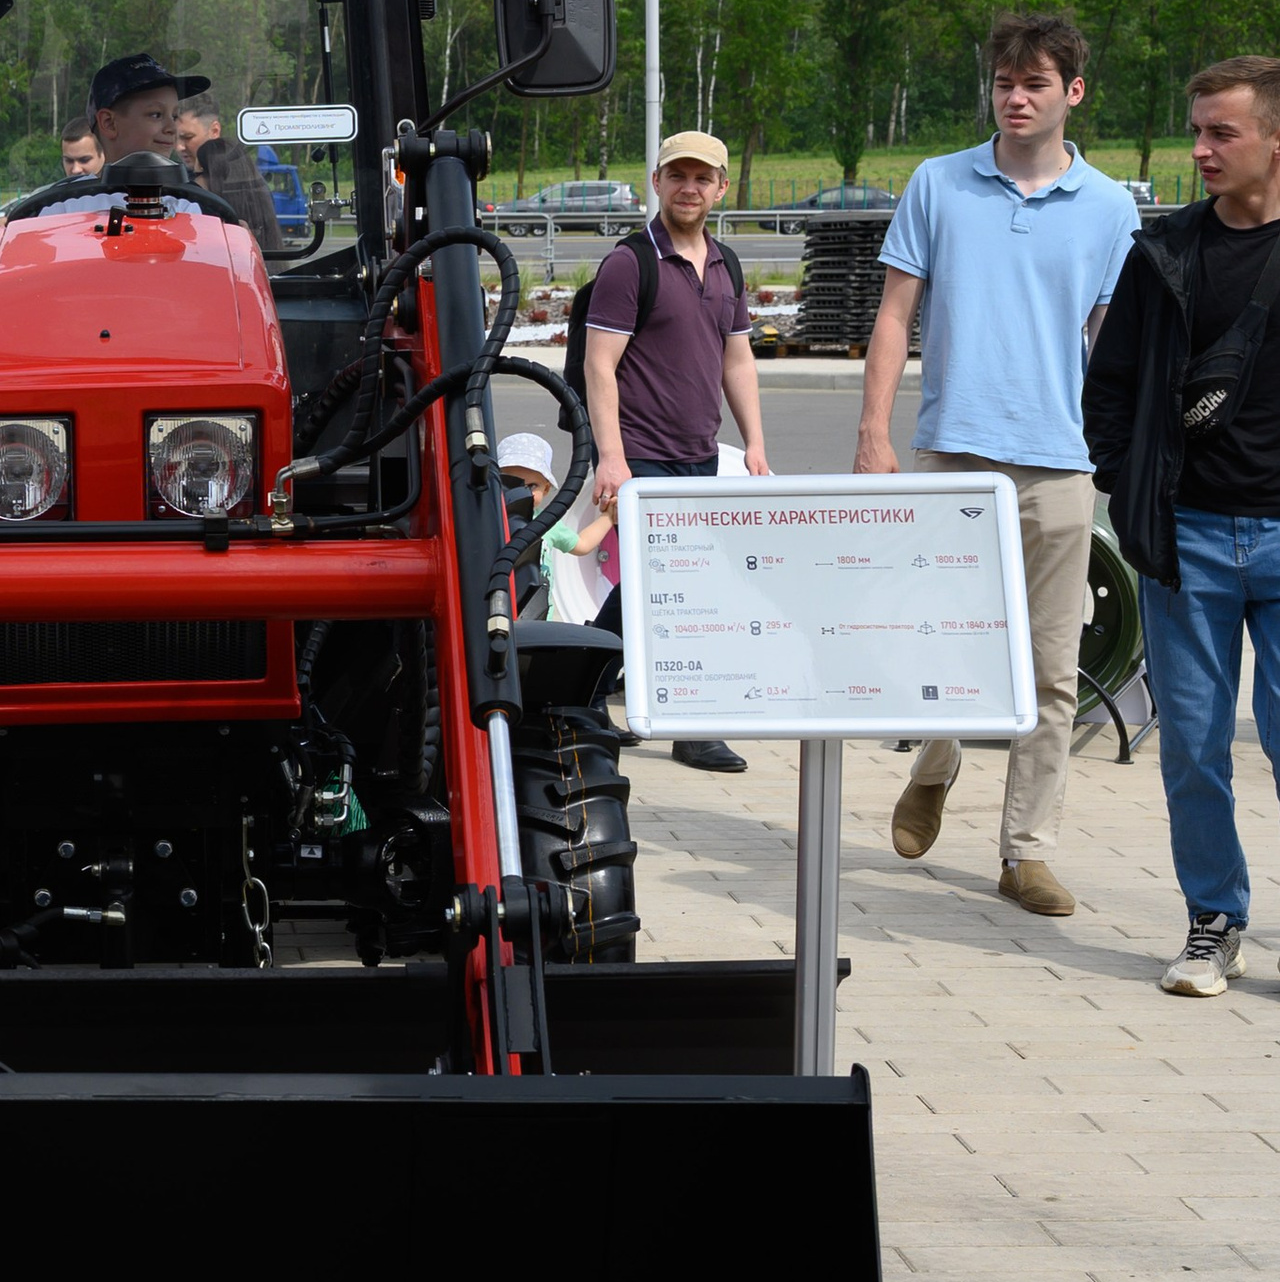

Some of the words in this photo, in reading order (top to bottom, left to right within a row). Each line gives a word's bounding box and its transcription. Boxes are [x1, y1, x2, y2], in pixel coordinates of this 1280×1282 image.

[646, 511, 763, 527] ТЕХНИЧЕСКИЕ
[768, 509, 915, 525] ХАРАКТЕРИСТИКИ
[647, 533, 677, 544] ОТ-18
[671, 544, 714, 553] ТРАКТОРНЫЙ
[669, 559, 689, 567] 2000
[761, 556, 773, 564] 110
[775, 557, 784, 565] кг
[837, 556, 856, 564] 1800
[935, 555, 954, 563] 1800
[963, 555, 978, 563] 590
[650, 593, 684, 605] ЩТ-15
[676, 608, 718, 616] ТРАКТОРНАЯ
[675, 624, 725, 633] 10400-13000
[766, 621, 780, 629] 295
[783, 621, 792, 630] кг
[849, 623, 888, 631] гидросистемы
[941, 621, 957, 629] 1710
[967, 621, 984, 629] 1840
[655, 674, 702, 683] ПОГРУЗОЧНОЕ
[704, 673, 757, 682] ОБОРУДОВАНИЕ
[673, 687, 688, 696] 320
[690, 688, 699, 696] кг
[767, 687, 779, 696] 0,3
[848, 686, 867, 694] 1700
[945, 687, 965, 695] 2700
